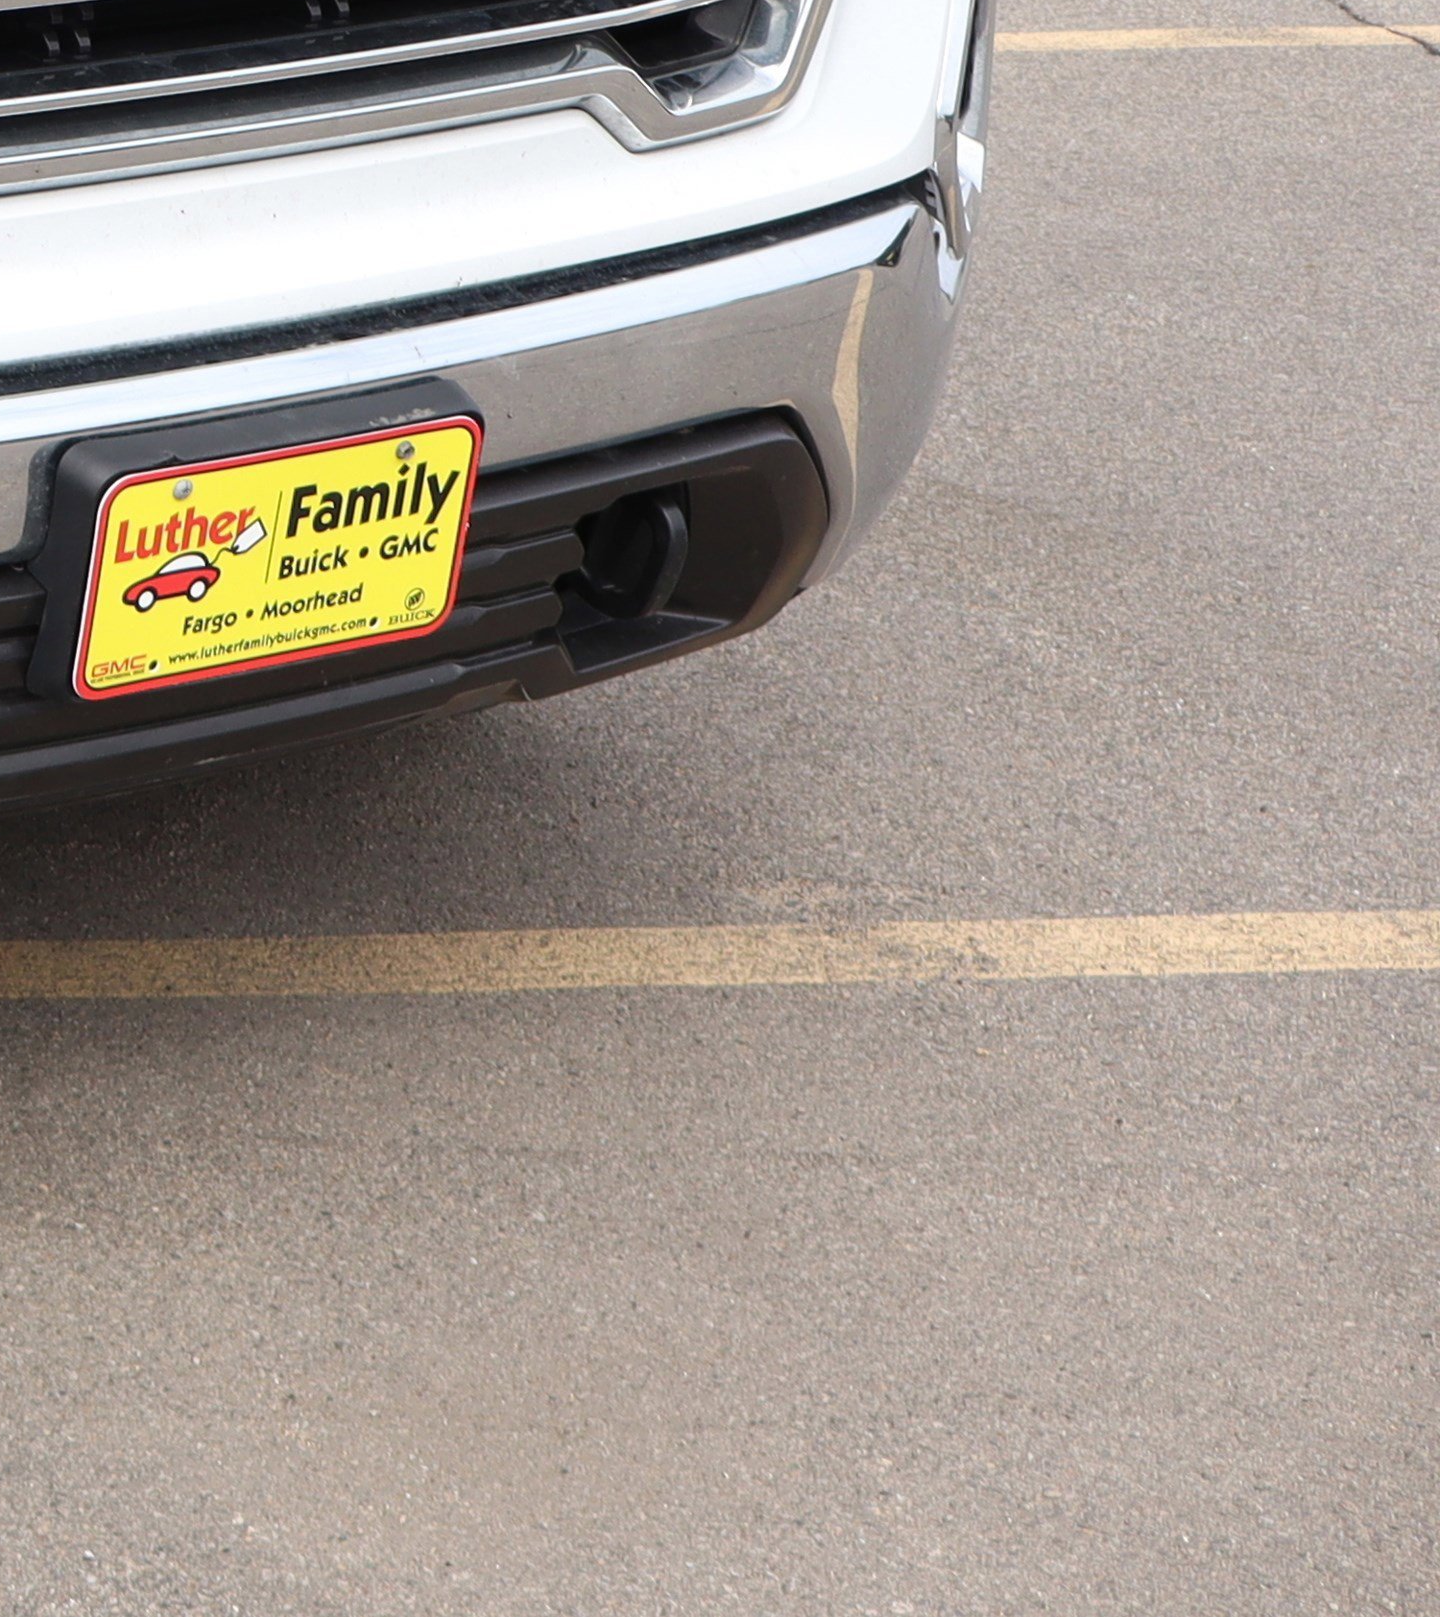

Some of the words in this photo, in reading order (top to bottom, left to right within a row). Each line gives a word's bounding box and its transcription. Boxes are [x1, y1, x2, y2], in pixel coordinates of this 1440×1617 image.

[114, 506, 257, 564] Luther
[285, 461, 461, 539] Family
[278, 544, 349, 580] Buick
[379, 527, 439, 560] GMC
[182, 610, 238, 636] Fargo
[260, 582, 364, 620] Moorhead
[387, 607, 437, 626] BUICK
[91, 653, 148, 678] GMC
[168, 616, 367, 666] www.lutherfamilybuickgmc.com
